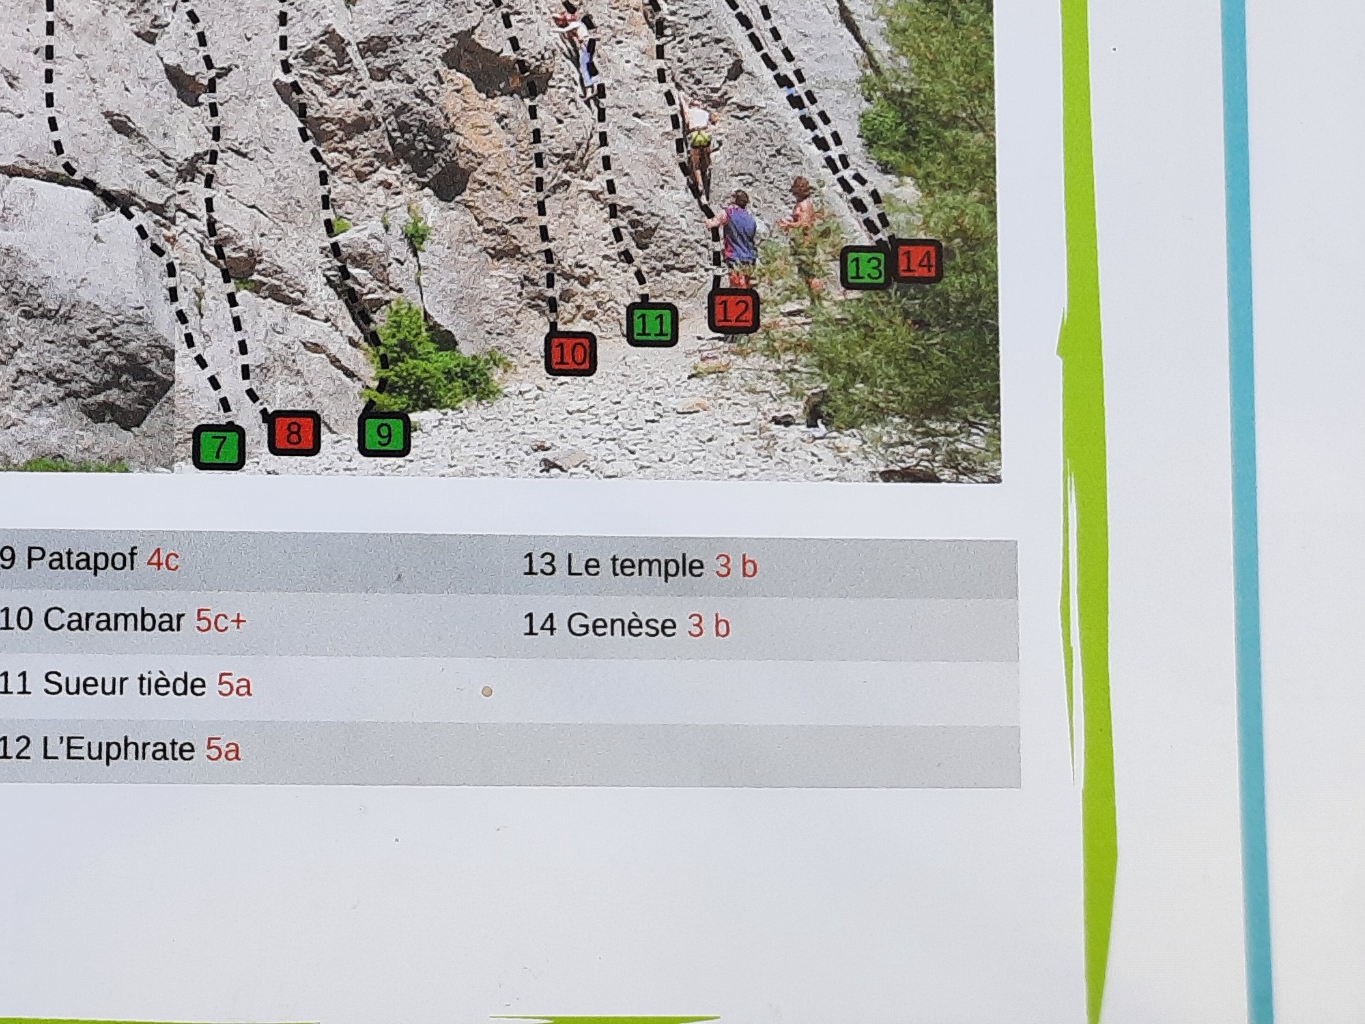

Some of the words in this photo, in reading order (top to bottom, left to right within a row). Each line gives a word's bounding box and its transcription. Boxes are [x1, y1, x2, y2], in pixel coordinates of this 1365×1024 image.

[849, 256, 884, 281] 13
[901, 250, 934, 273] 14
[717, 299, 750, 323] 12
[635, 312, 669, 338] 11
[554, 341, 588, 366] 10
[286, 421, 303, 446] 8
[376, 422, 393, 448] 9
[210, 435, 228, 460] 7
[0, 545, 16, 570] 9
[26, 545, 138, 578] Patapof
[146, 547, 180, 572] 4c
[522, 551, 557, 577] 13
[567, 552, 601, 577] Le
[610, 552, 705, 584] temple
[715, 553, 732, 578] 3
[741, 553, 758, 578] b
[0, 605, 34, 632] 10
[43, 605, 186, 633] Carambar
[195, 607, 247, 633] 5c+
[523, 611, 557, 637] 14
[566, 611, 677, 638] Genèse
[687, 613, 704, 638] 3
[714, 612, 731, 639] b
[43, 670, 130, 696] Sueur
[137, 669, 207, 697] tiède
[217, 671, 253, 697] 5a
[205, 736, 242, 762] 5a
